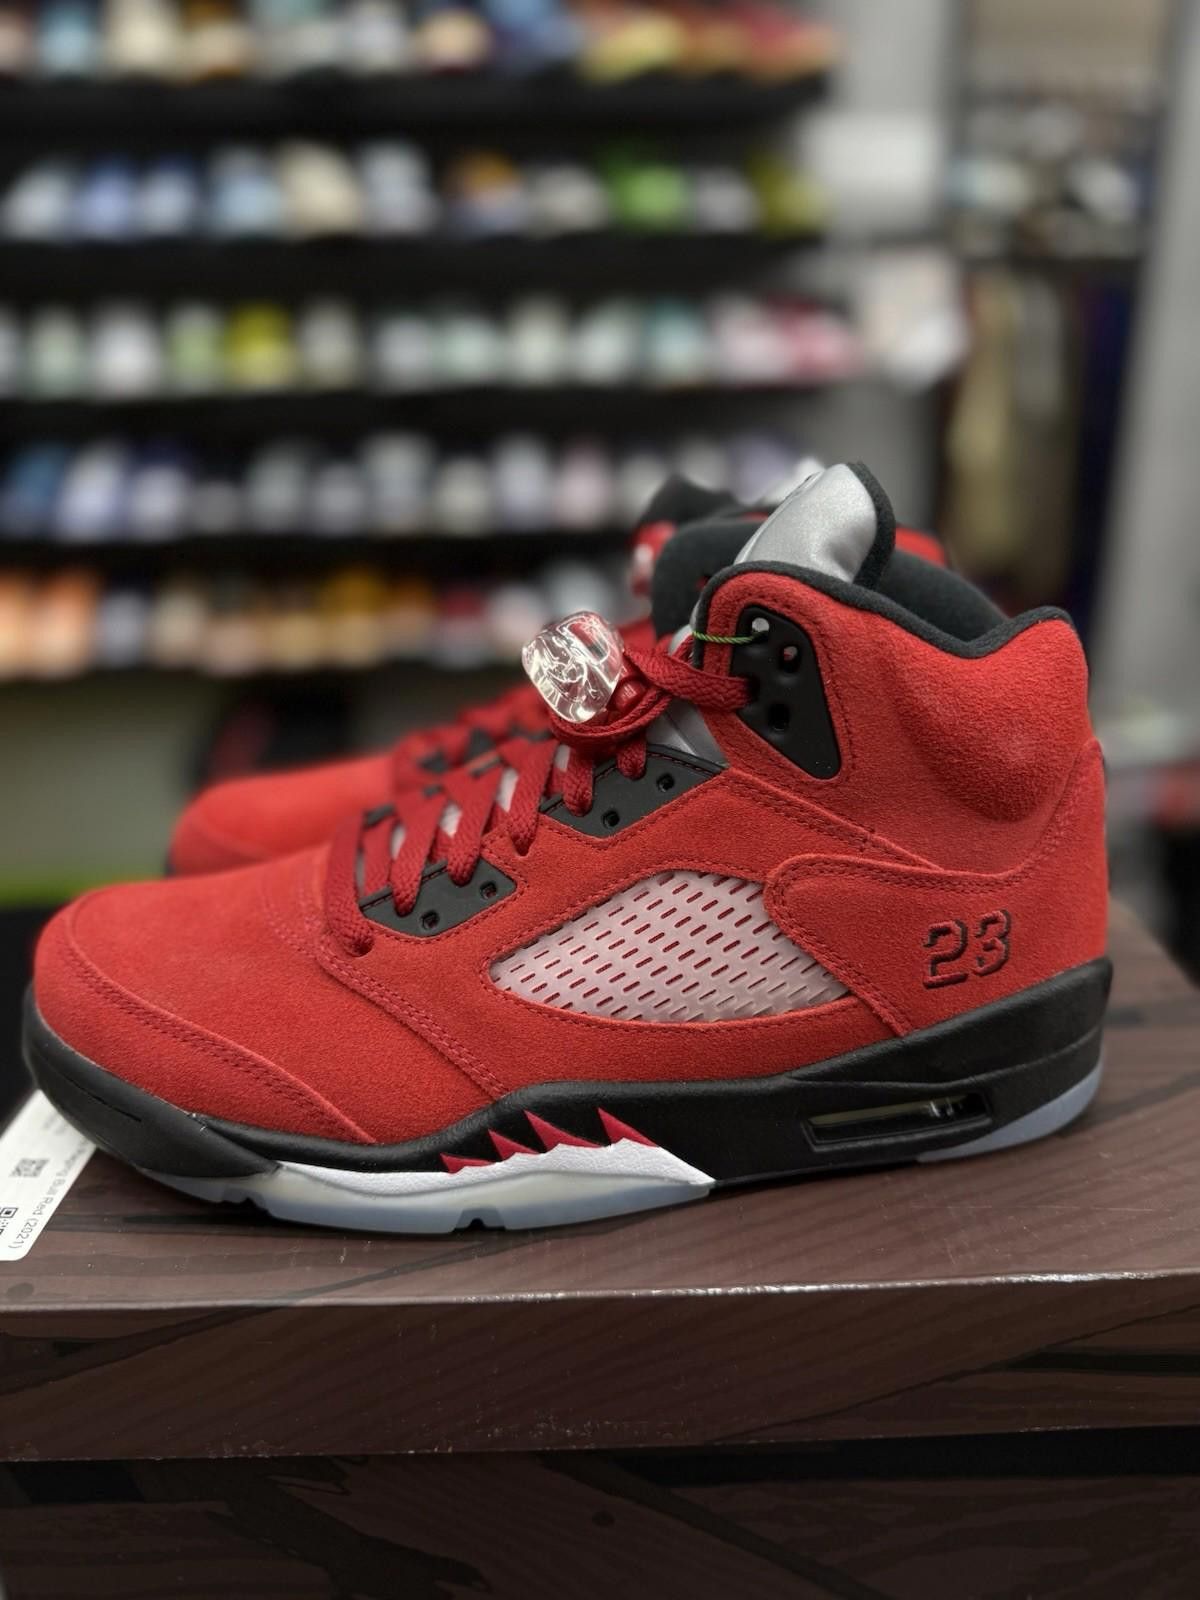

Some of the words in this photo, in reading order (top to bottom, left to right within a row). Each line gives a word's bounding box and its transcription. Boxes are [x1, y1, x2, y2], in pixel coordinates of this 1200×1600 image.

[922, 909, 1011, 990] 23
[33, 1197, 54, 1216] Red
[8, 1218, 39, 1249] (2021)
